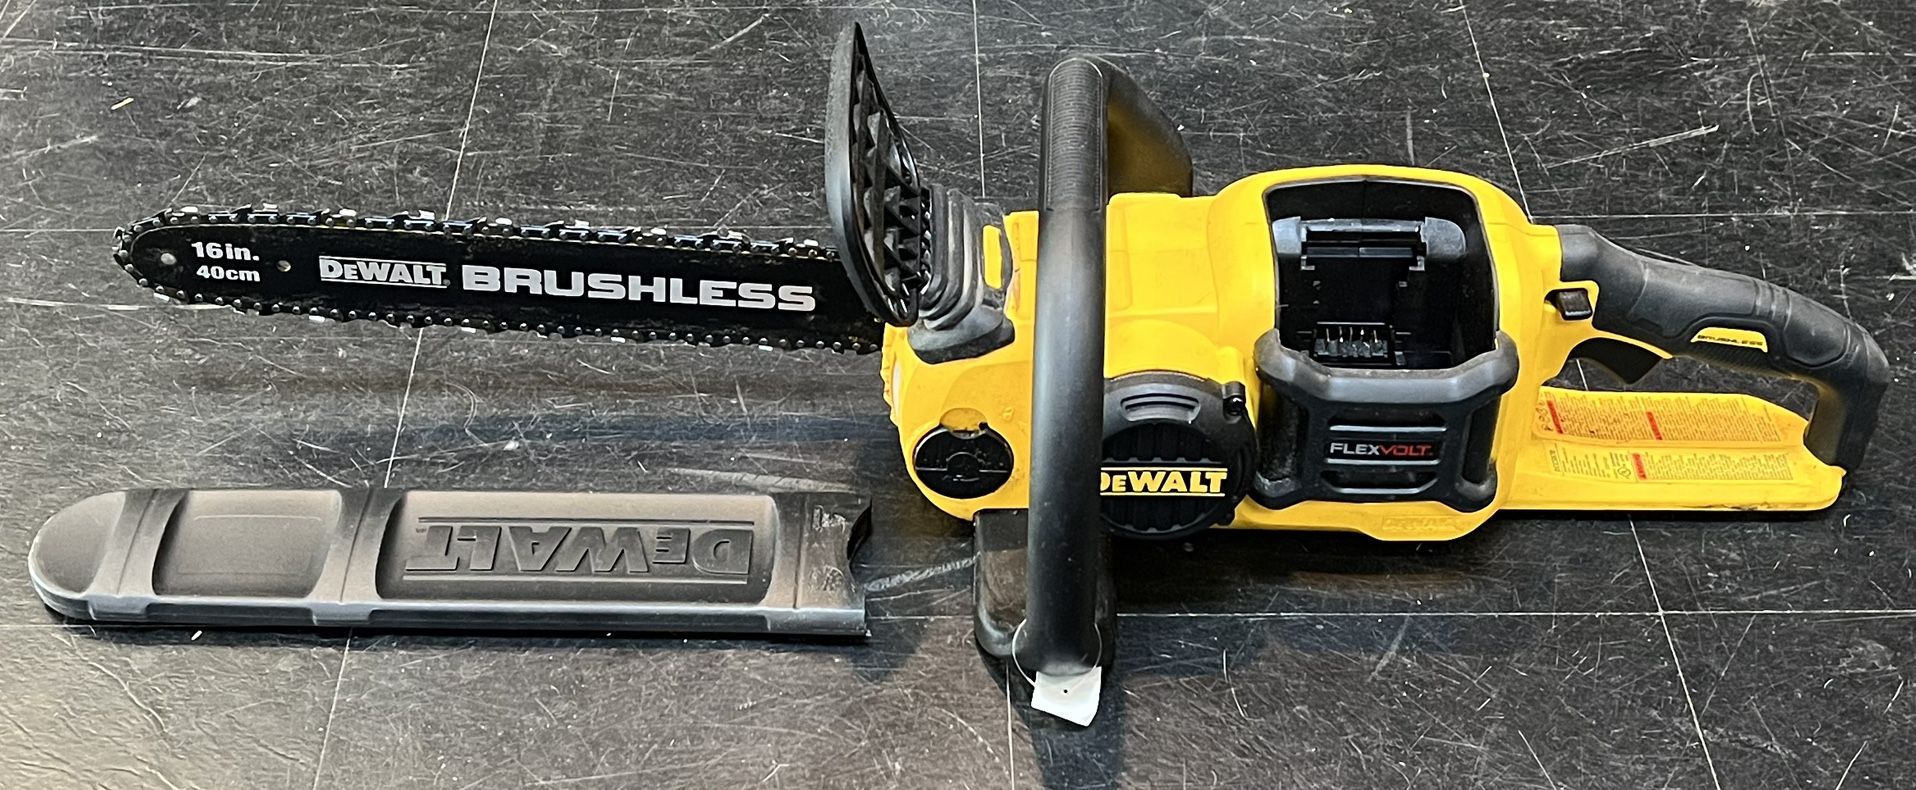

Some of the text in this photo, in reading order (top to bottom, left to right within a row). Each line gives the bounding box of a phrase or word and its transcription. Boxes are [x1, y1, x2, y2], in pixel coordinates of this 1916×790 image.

[196, 265, 260, 282] 40cm
[319, 258, 816, 312] DEWALT BRUSHLESS
[1330, 442, 1432, 456] FLEXVOLT
[405, 525, 755, 576] DEWALT
